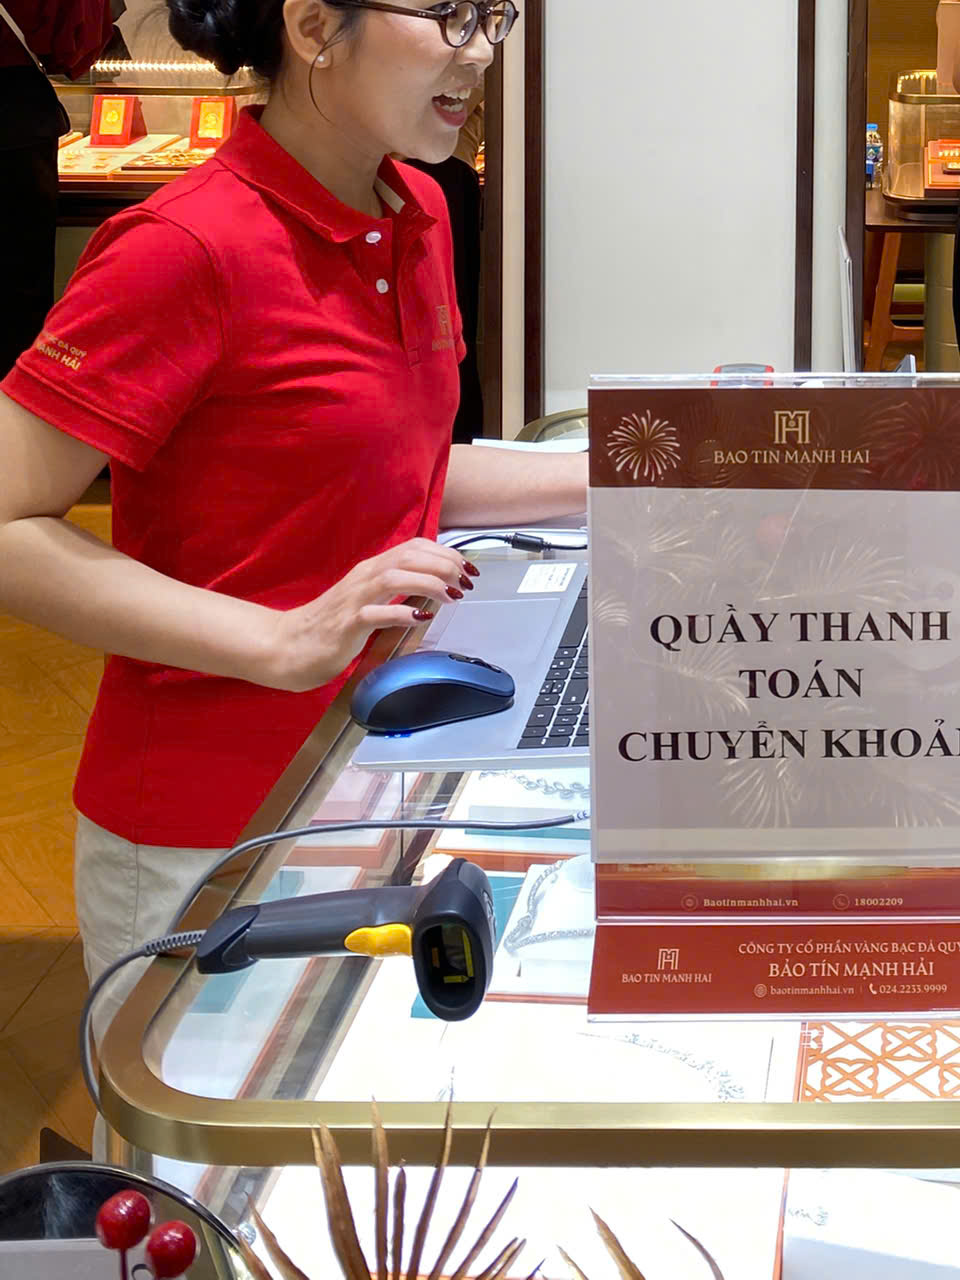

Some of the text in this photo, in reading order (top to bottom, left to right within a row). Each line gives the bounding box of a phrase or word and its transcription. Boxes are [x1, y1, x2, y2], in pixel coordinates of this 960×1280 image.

[714, 449, 870, 465] BAO TIN MANH HAI
[649, 603, 951, 652] QUẦY THANH
[738, 659, 864, 699] TOÁN
[618, 721, 809, 762] CHUYỂN
[855, 897, 904, 906] 18002209
[777, 943, 793, 954] TY
[891, 942, 916, 955] BẠC
[768, 957, 934, 980] BẢO TÍN MẠNH HẢI
[770, 984, 948, 995] baotinmanhhai.vn 024.2233.9999
